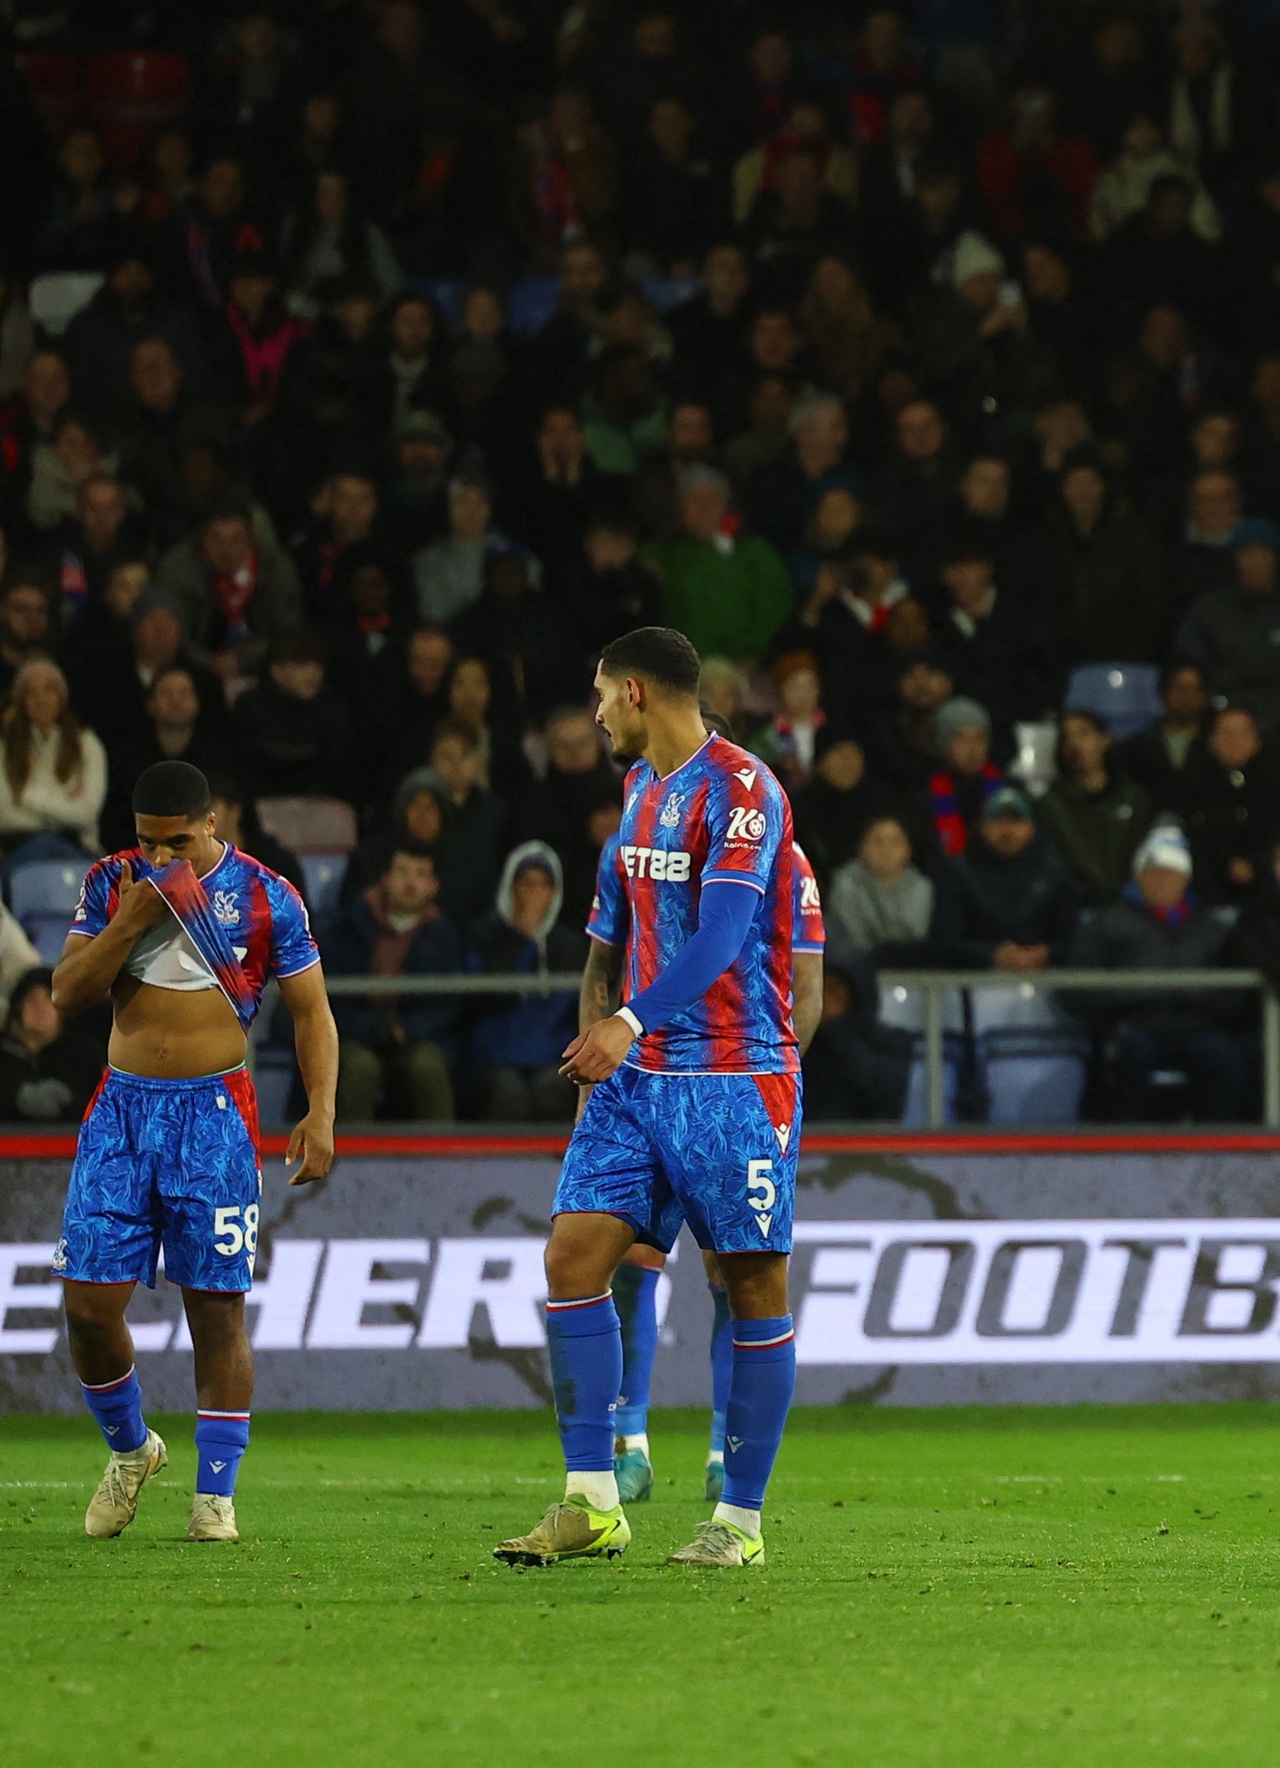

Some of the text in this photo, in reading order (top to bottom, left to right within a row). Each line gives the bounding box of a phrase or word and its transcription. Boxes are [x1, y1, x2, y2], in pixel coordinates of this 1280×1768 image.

[620, 845, 691, 882] ET88
[747, 1159, 776, 1211] 5
[214, 1203, 259, 1256] 58
